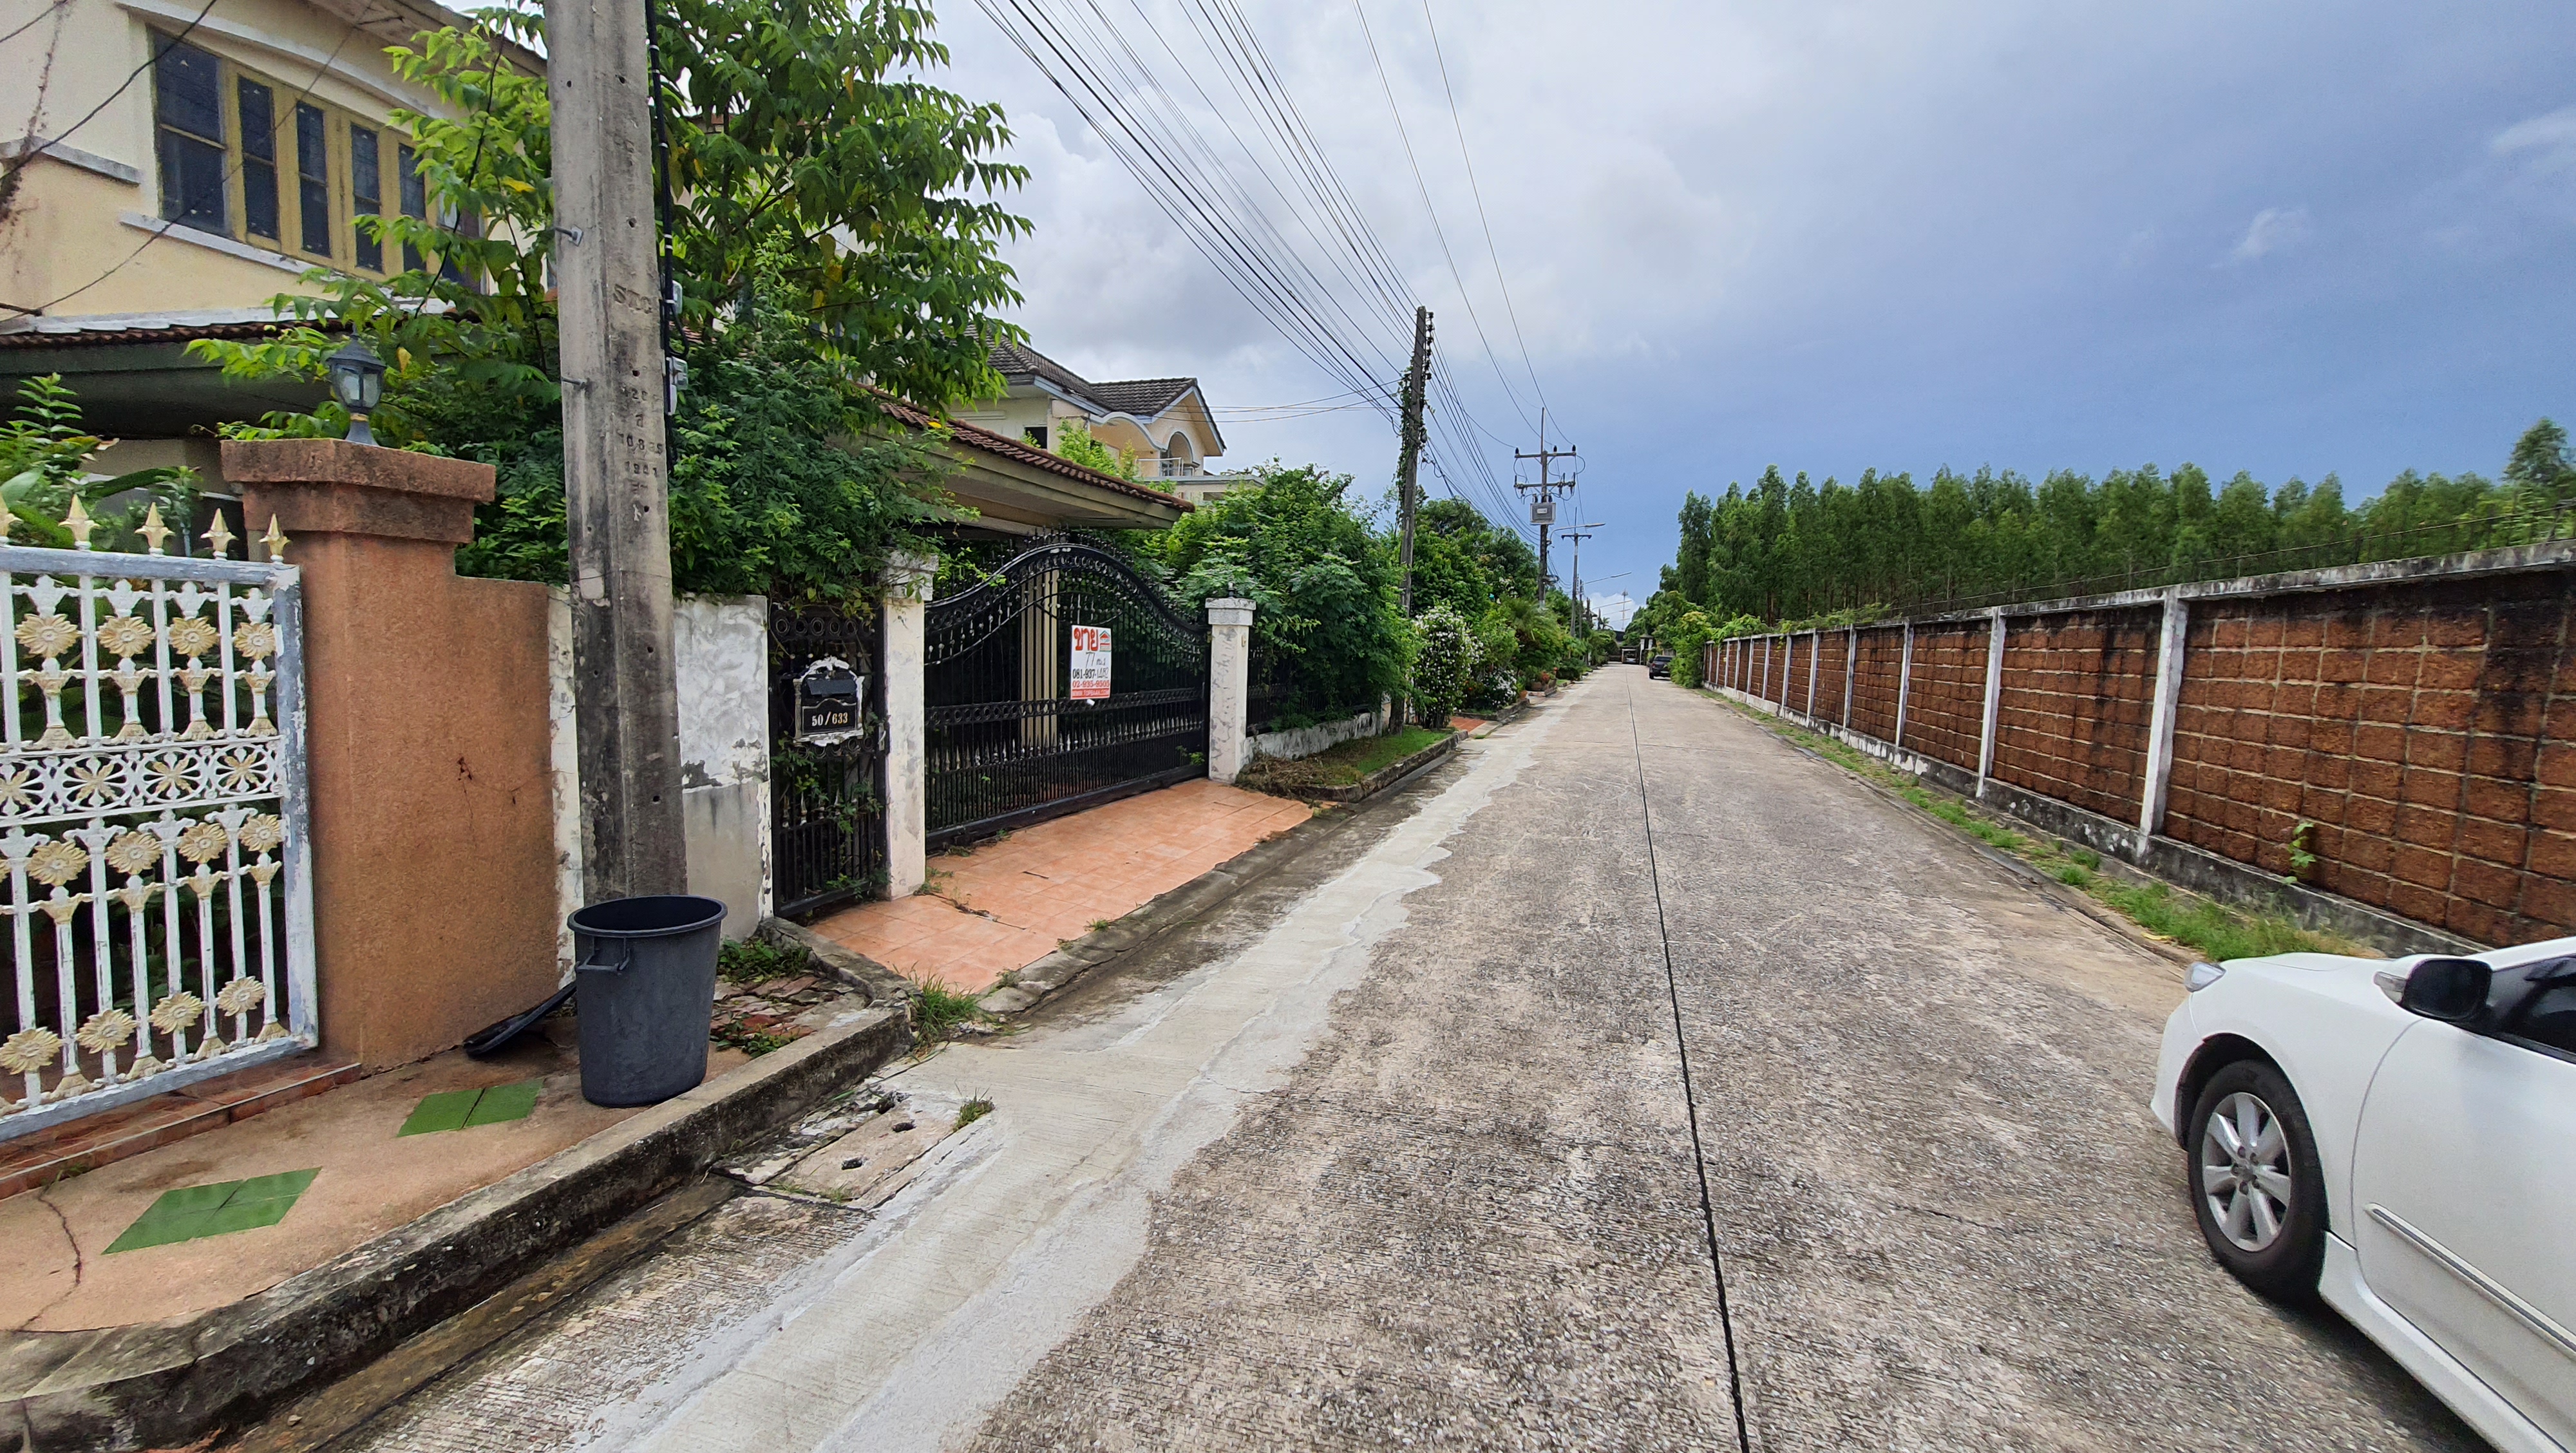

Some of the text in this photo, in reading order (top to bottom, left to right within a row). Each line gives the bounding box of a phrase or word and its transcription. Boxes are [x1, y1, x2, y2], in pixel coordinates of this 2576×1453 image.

[1074, 627, 1099, 652] ขาย
[1086, 652, 1096, 668] 77
[811, 711, 848, 726] 50/633
